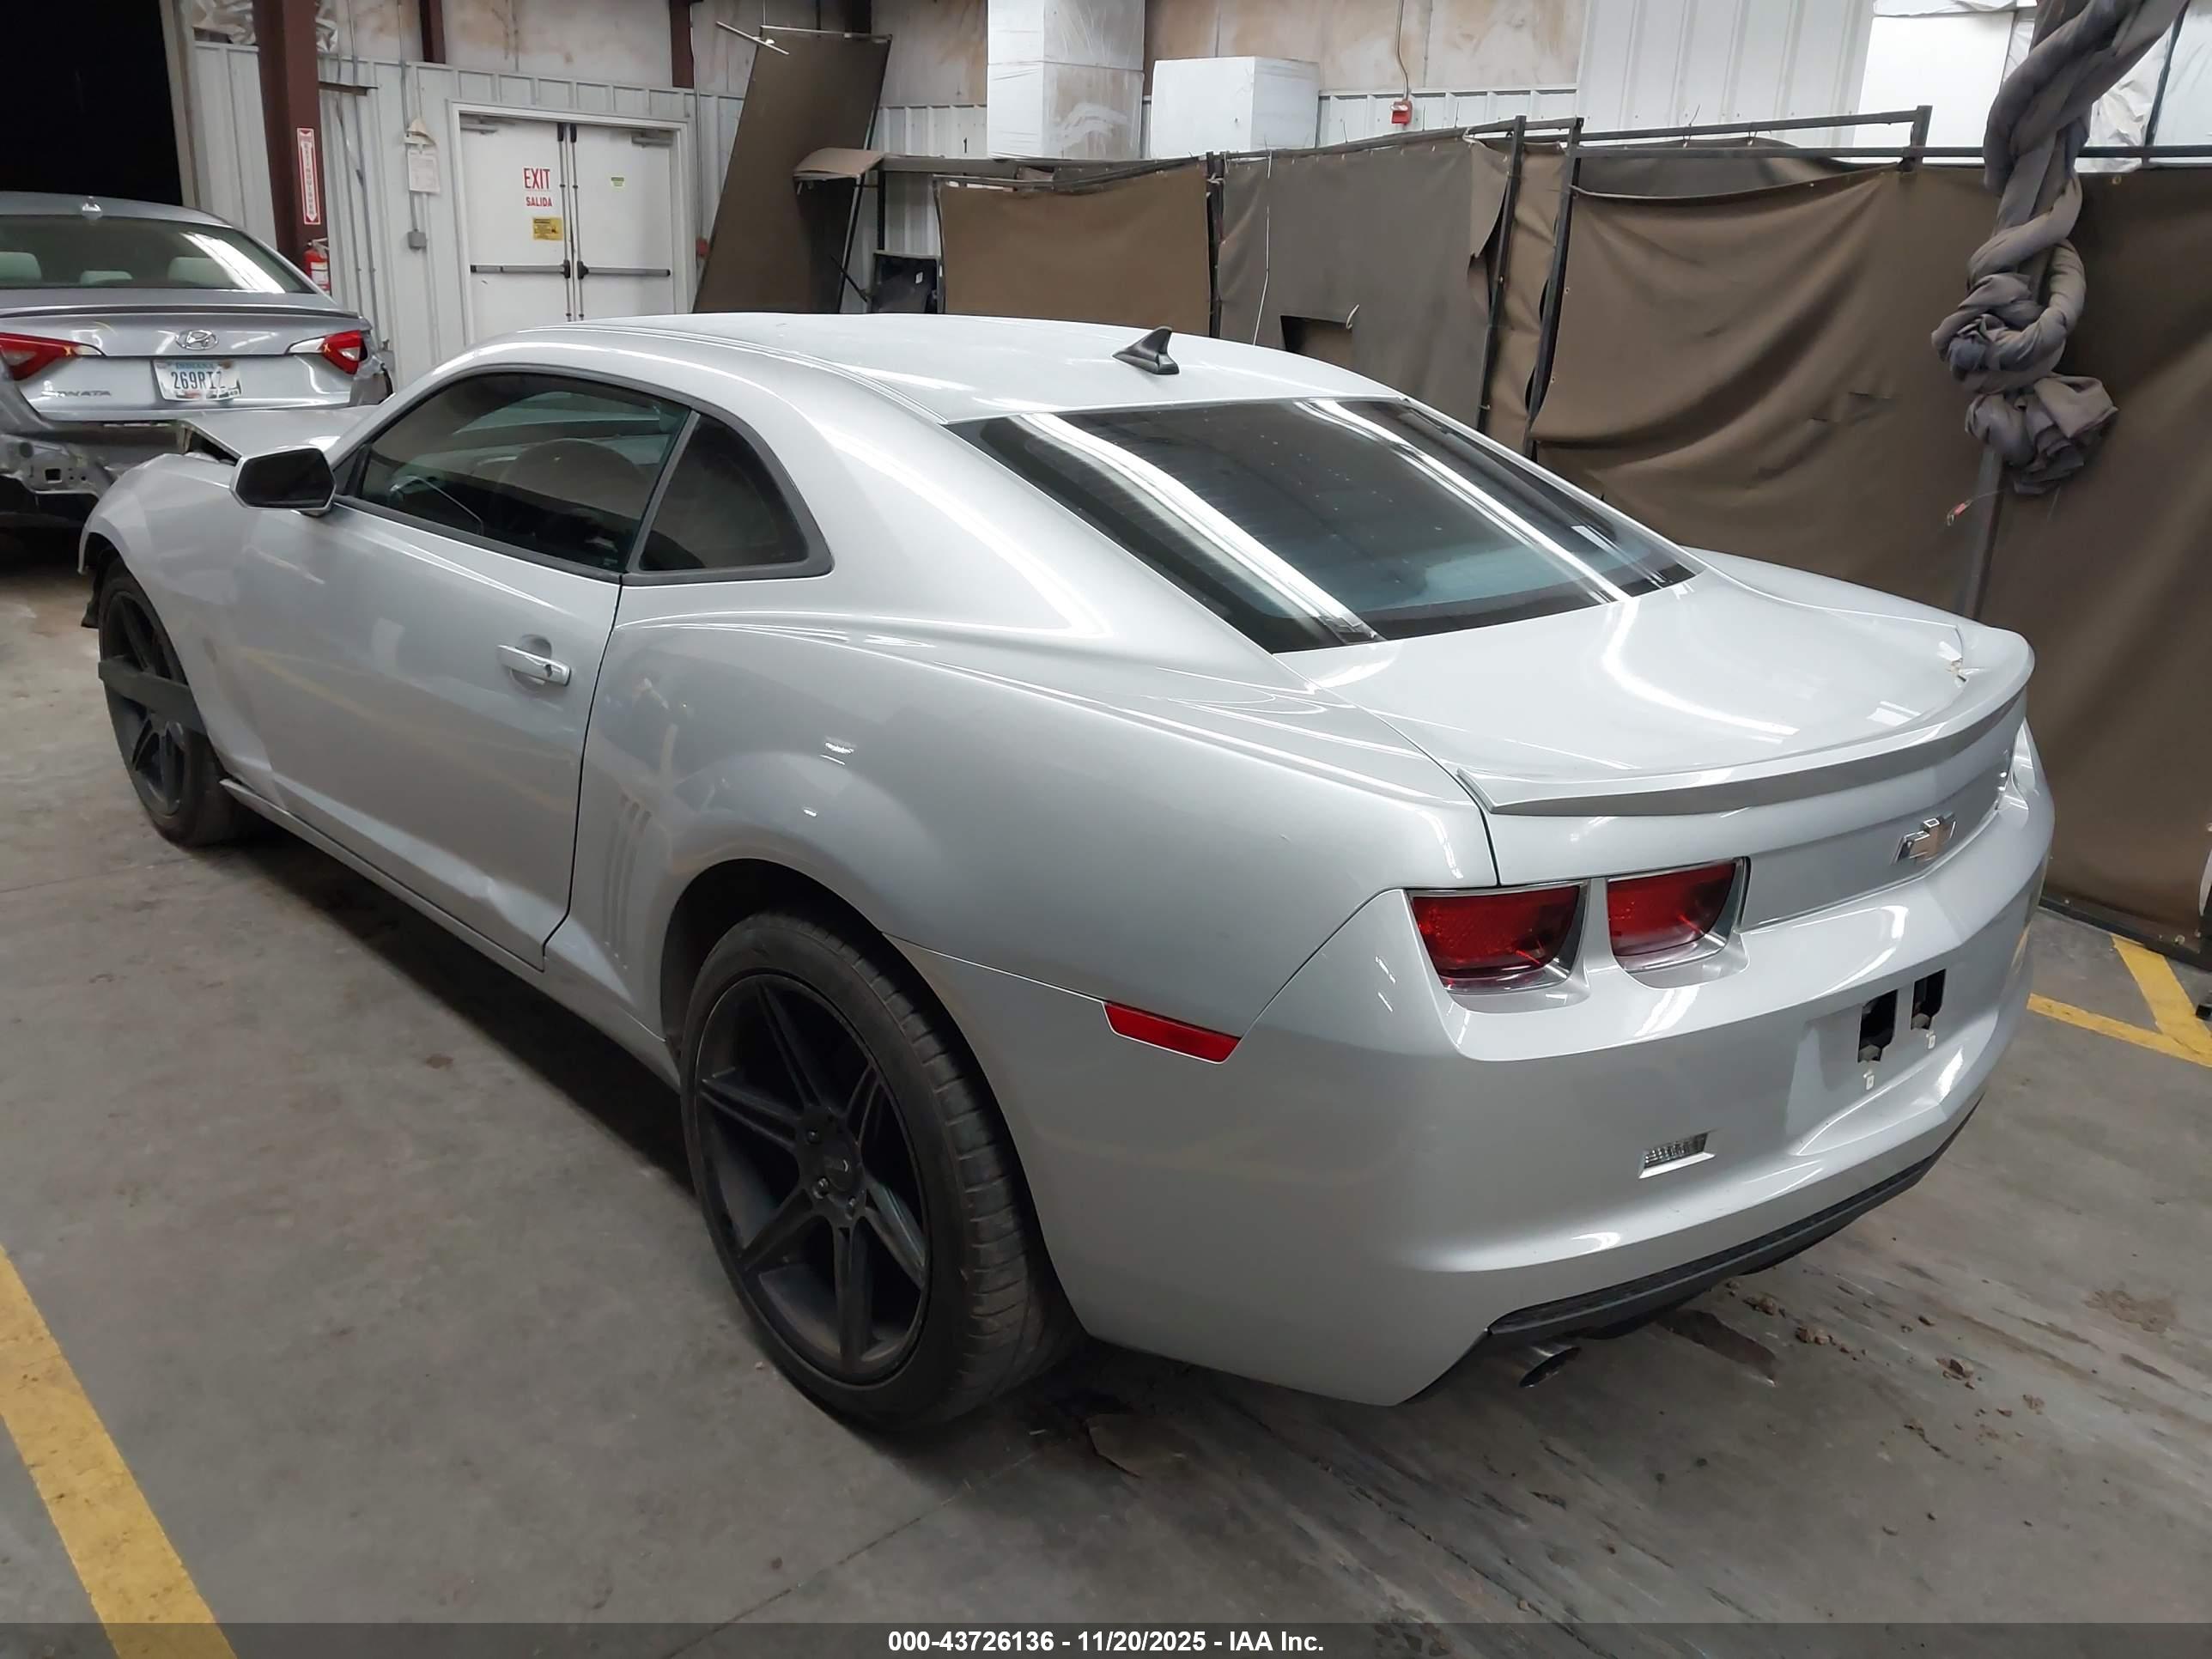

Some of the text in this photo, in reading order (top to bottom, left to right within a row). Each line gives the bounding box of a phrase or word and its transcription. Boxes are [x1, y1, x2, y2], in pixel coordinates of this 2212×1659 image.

[963, 137, 968, 154] 1
[523, 167, 550, 189] EXIT
[526, 196, 553, 207] SALIDA
